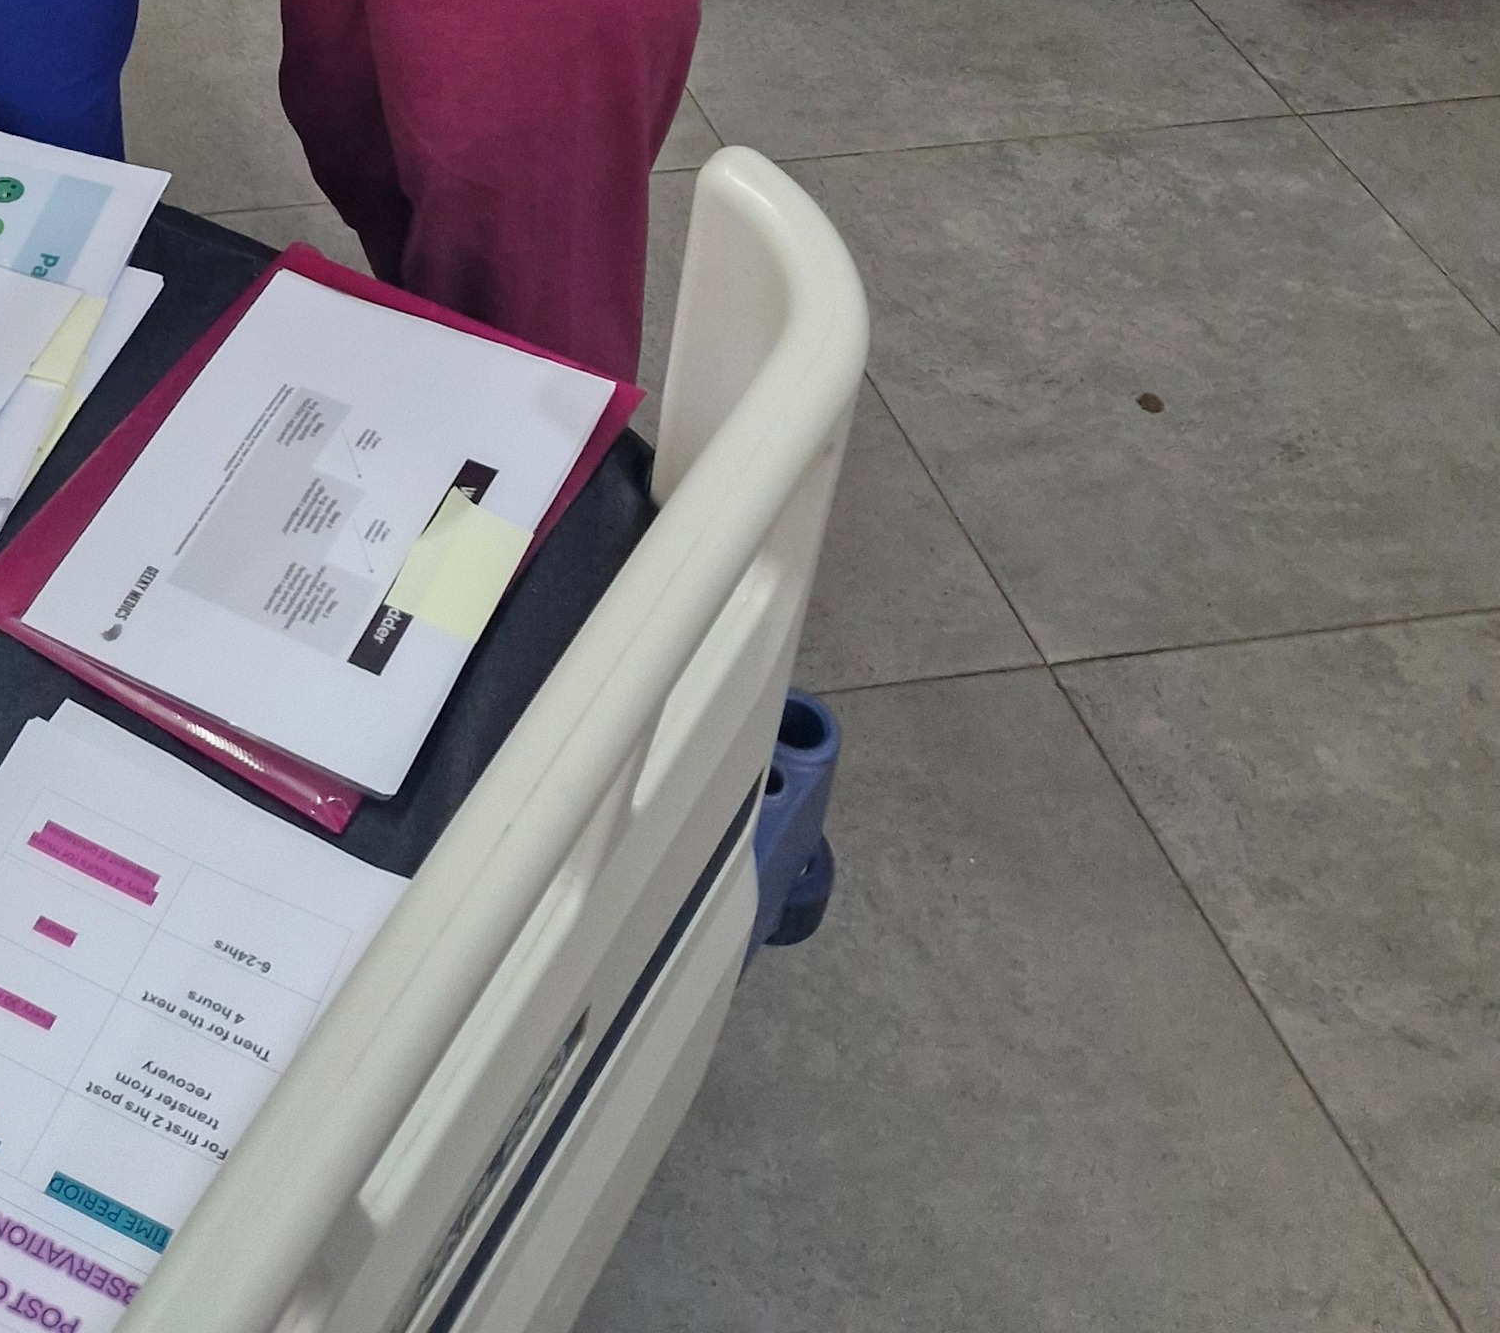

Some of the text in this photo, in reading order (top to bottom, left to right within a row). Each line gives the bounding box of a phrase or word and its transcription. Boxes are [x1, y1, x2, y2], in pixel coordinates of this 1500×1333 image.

[31, 252, 60, 278] Pa
[114, 565, 159, 621] GEEKY MEDICS
[211, 938, 272, 974] 6-24hrs
[139, 989, 273, 1062] Then for the next
[185, 989, 245, 1026] 4 hours
[113, 1071, 220, 1131] transfer from
[140, 1058, 212, 1102] recovery
[84, 1079, 229, 1161] For first 2 hrs post
[46, 1173, 171, 1248] TIME PERIOD
[6, 1286, 81, 1333] POST
